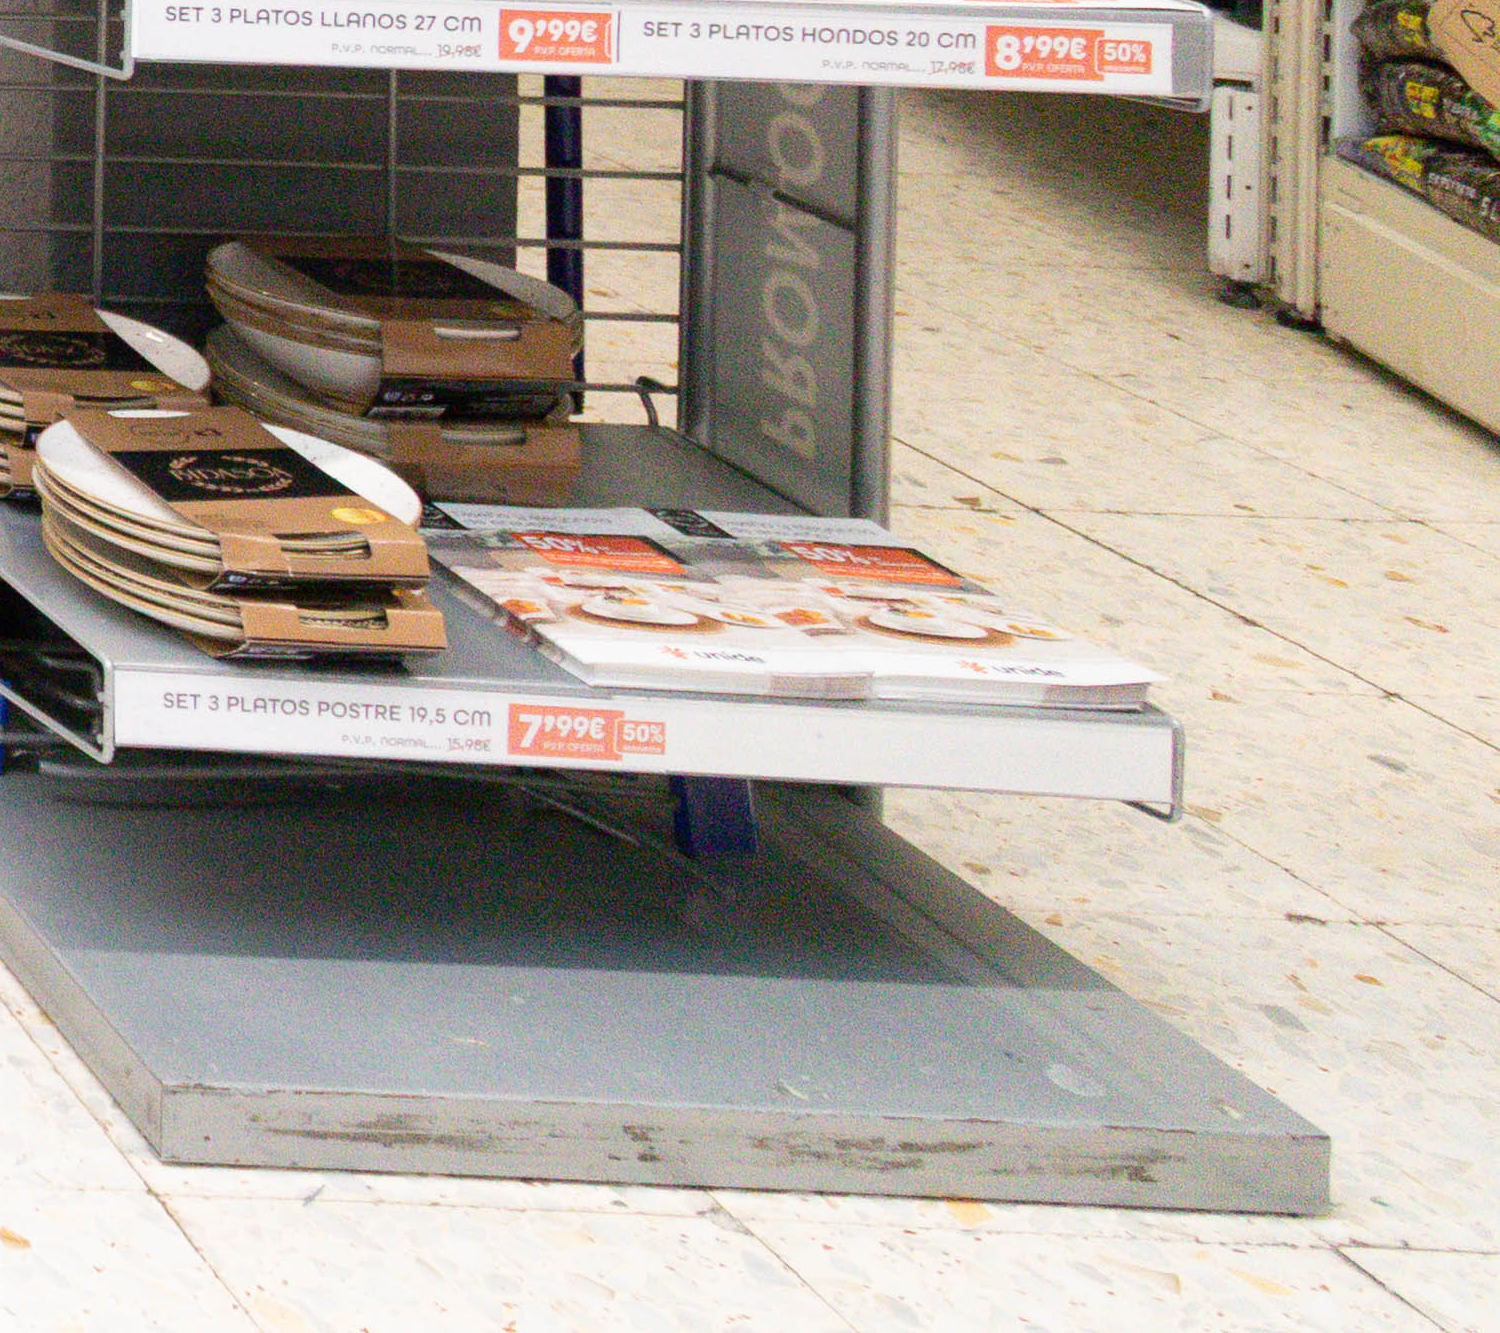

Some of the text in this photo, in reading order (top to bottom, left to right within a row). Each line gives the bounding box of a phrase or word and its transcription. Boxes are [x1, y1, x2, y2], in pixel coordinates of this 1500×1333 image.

[165, 5, 483, 33] SET 3 PLATOS LLANOS 27 CM
[643, 20, 977, 51] SET 3 PLATOS HONDOS 20 CM
[1103, 43, 1148, 64] 50%
[162, 692, 492, 728] SET 3 PLATOS POSTRE 19,5 CM
[622, 722, 662, 745] 50%
